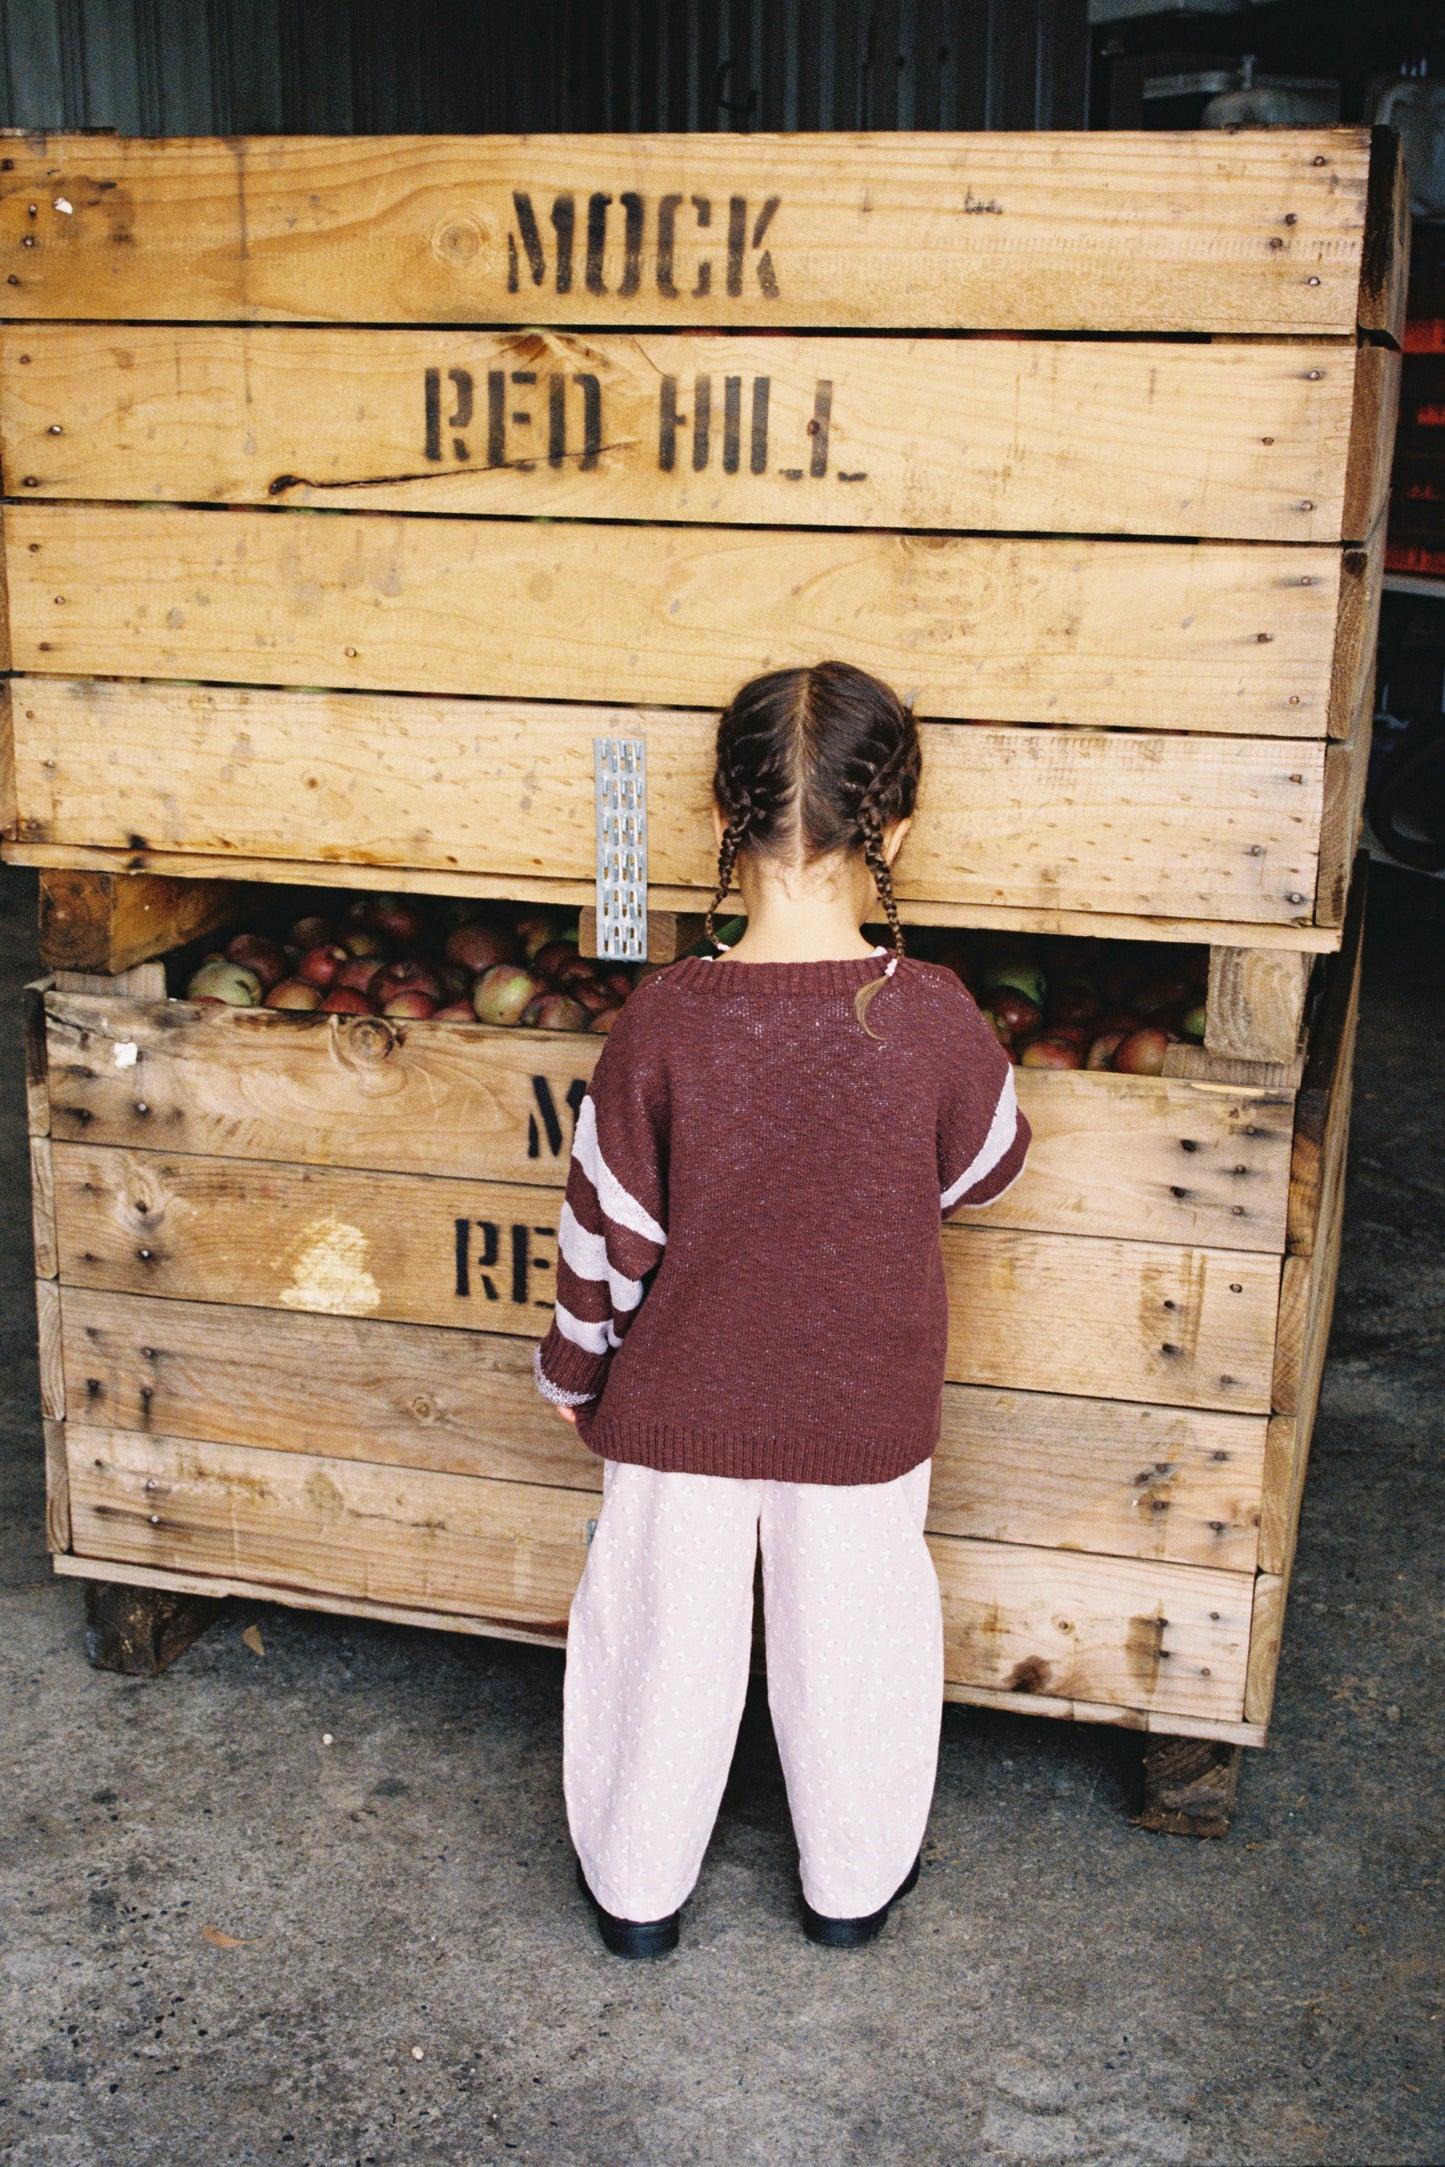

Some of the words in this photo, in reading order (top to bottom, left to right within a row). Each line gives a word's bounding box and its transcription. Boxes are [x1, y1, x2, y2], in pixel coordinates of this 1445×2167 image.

[507, 190, 781, 299] MOCK
[424, 367, 605, 473] RED
[659, 374, 868, 482] HILL
[455, 1217, 556, 1309] RE
